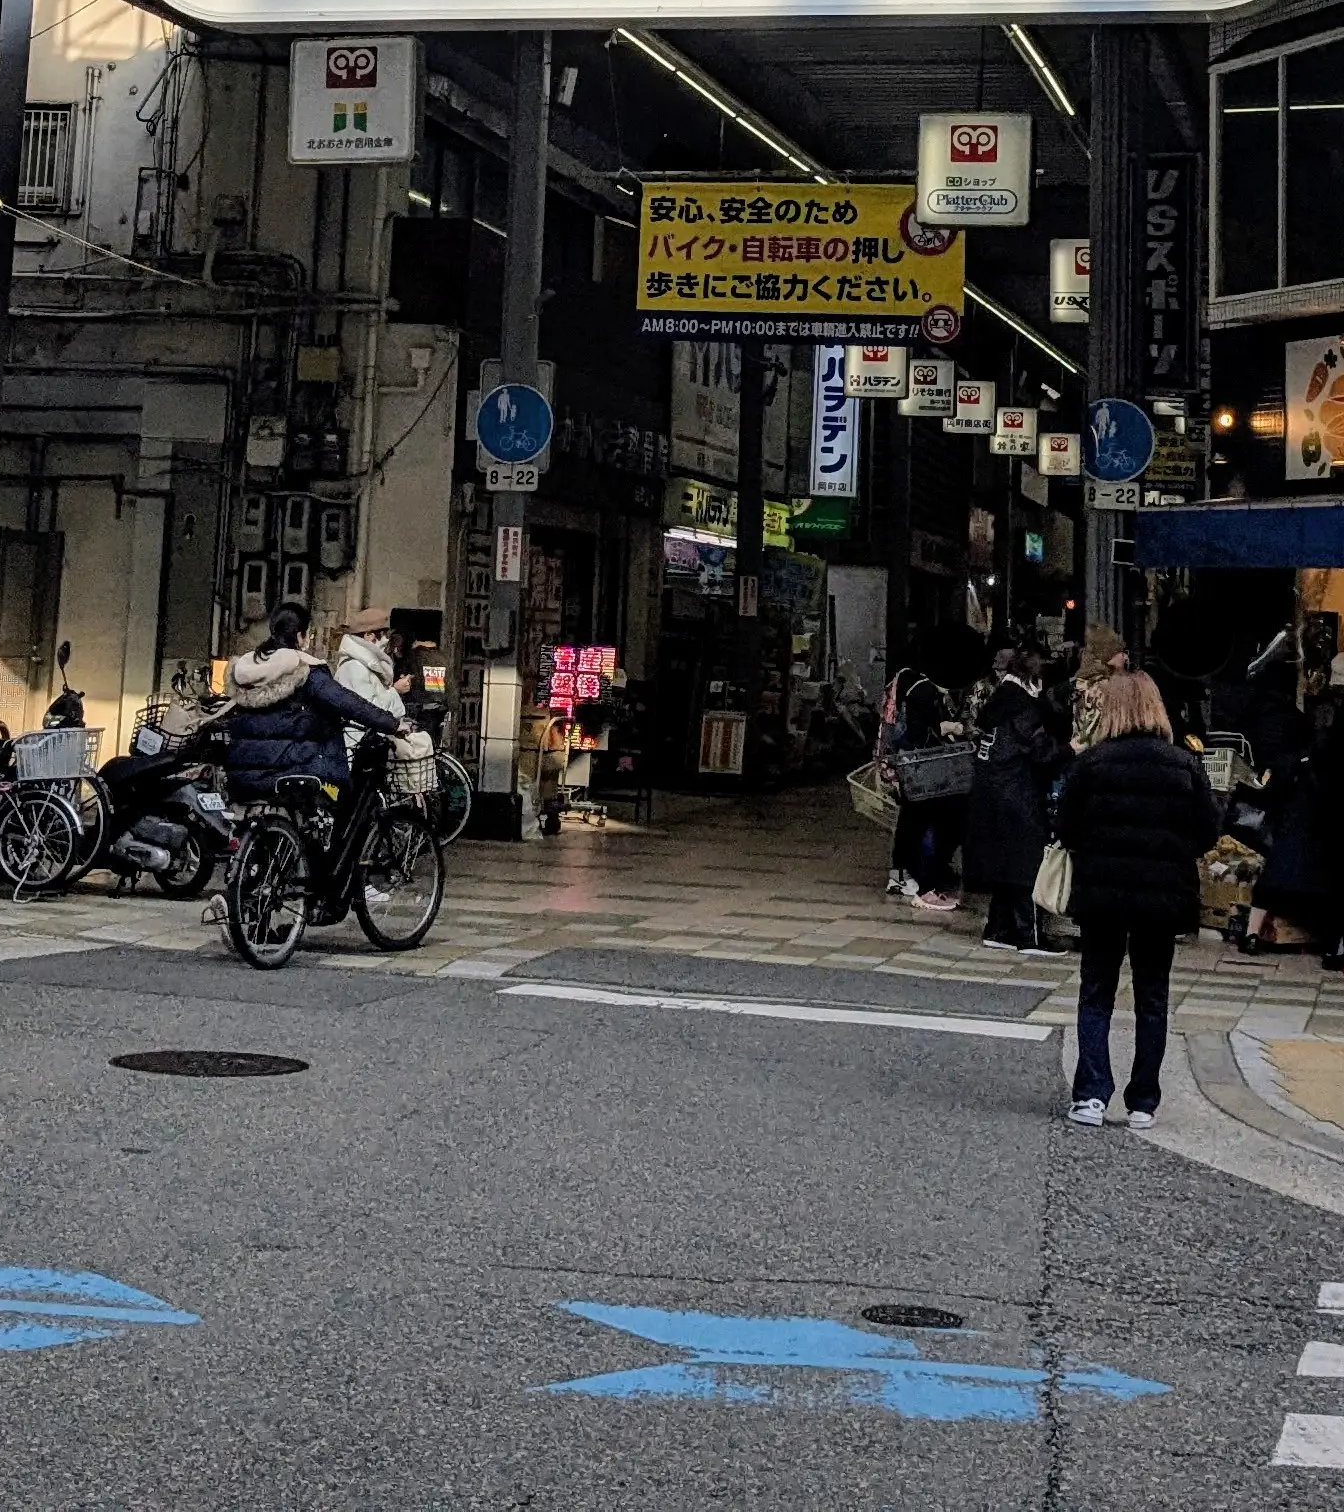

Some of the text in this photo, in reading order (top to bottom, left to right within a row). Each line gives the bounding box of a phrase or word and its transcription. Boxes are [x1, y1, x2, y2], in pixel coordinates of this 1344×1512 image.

[648, 196, 858, 225] 安心、安全のため
[647, 233, 905, 265] バイク・自転車の押し
[645, 271, 933, 304] 歩きにご協力ください。
